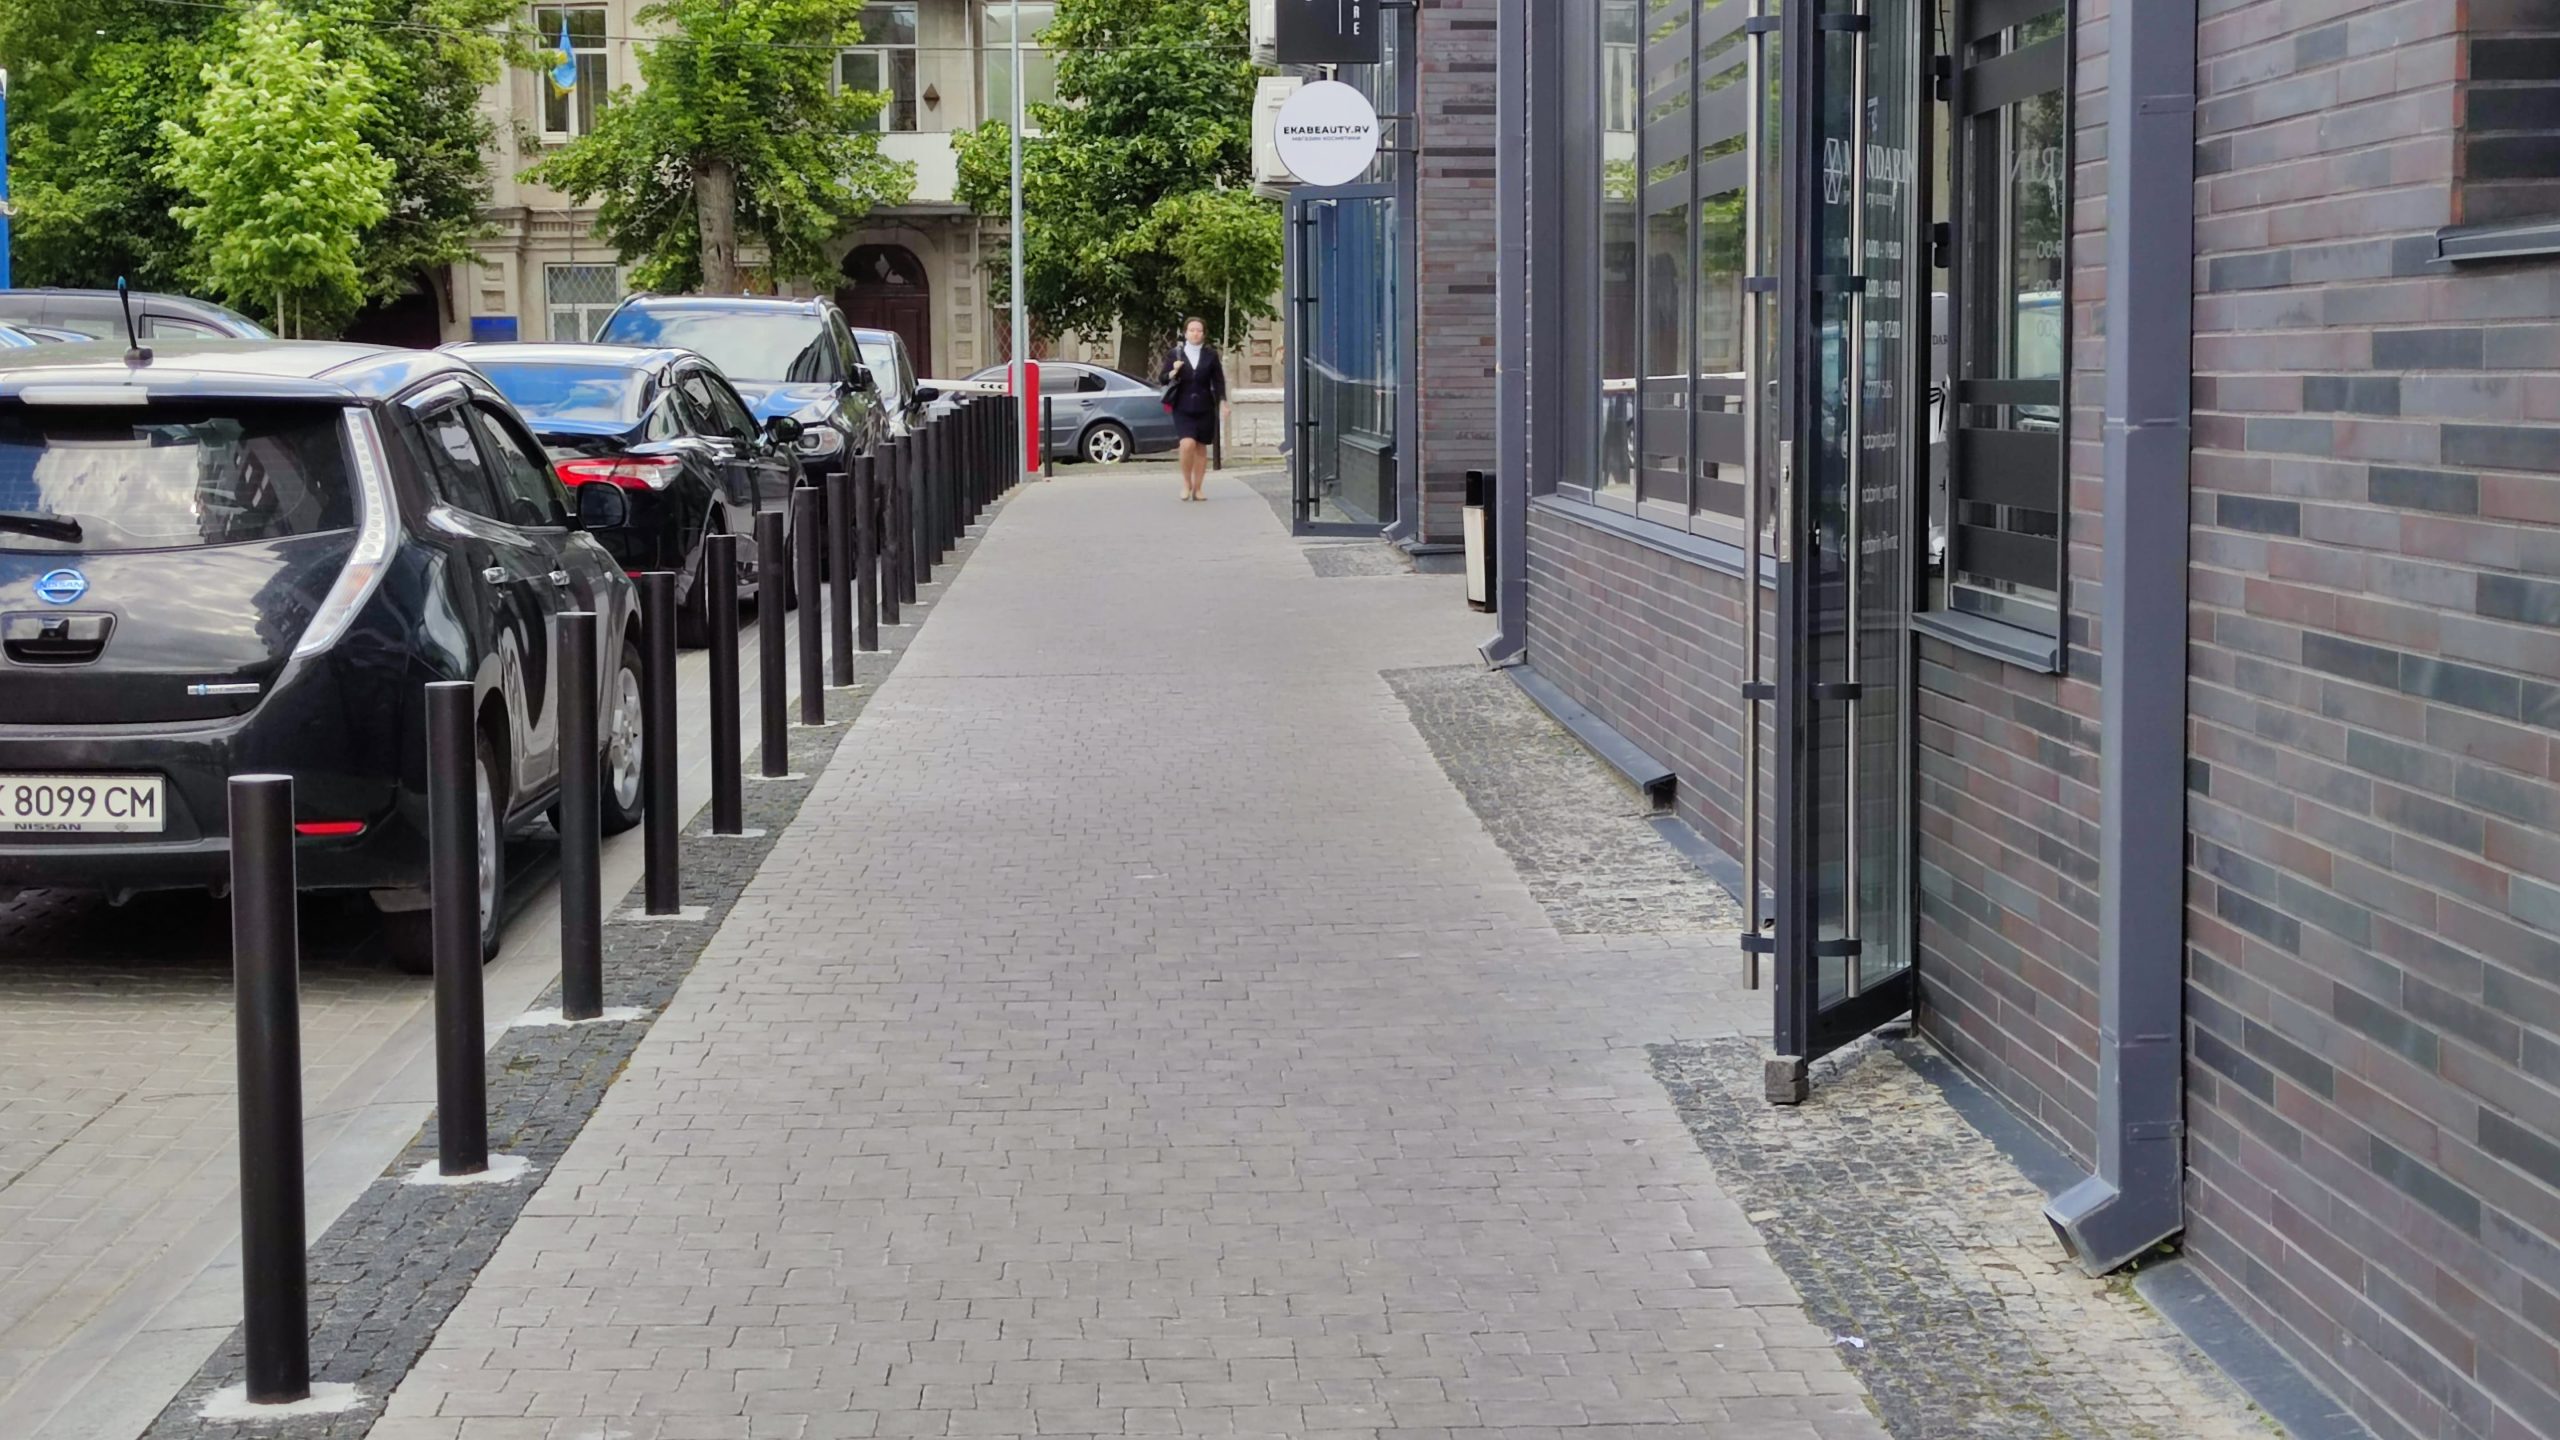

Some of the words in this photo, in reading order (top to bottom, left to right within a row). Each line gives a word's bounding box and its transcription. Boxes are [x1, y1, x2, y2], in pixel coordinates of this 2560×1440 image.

[1283, 125, 1370, 135] EKABEAUTY.RV
[15, 785, 96, 817] 8099
[104, 786, 155, 818] CM
[14, 823, 82, 831] NISSAN
